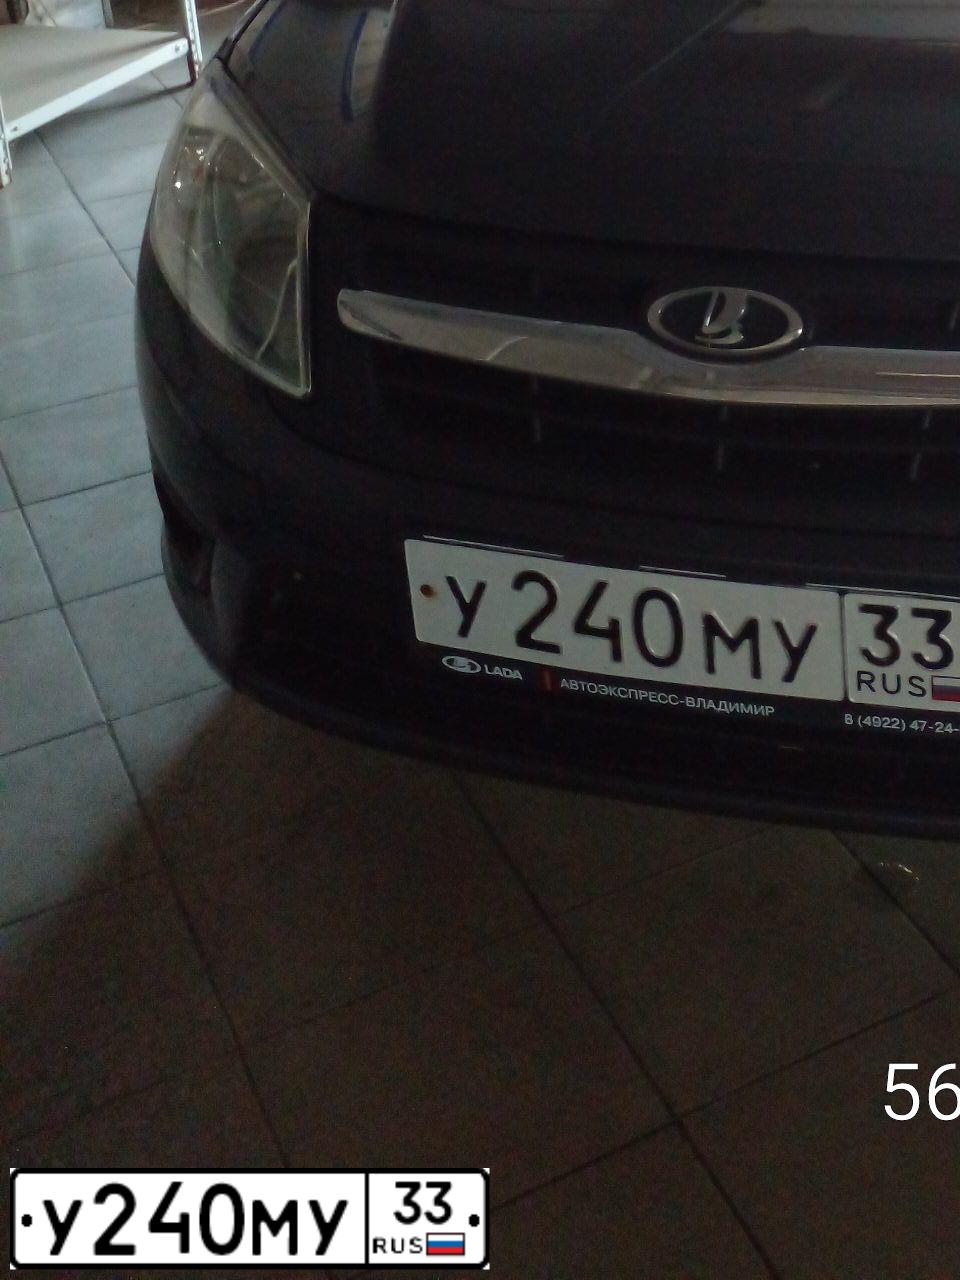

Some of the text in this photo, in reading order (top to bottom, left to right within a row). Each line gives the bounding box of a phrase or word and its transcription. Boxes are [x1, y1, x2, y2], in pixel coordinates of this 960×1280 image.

[858, 603, 955, 671] 33
[484, 663, 523, 681] LADA
[856, 669, 927, 698] RUS
[559, 677, 776, 718] АВТОЭКСПРЕСС-ВЛАДИМИР
[857, 715, 906, 732] (4922)
